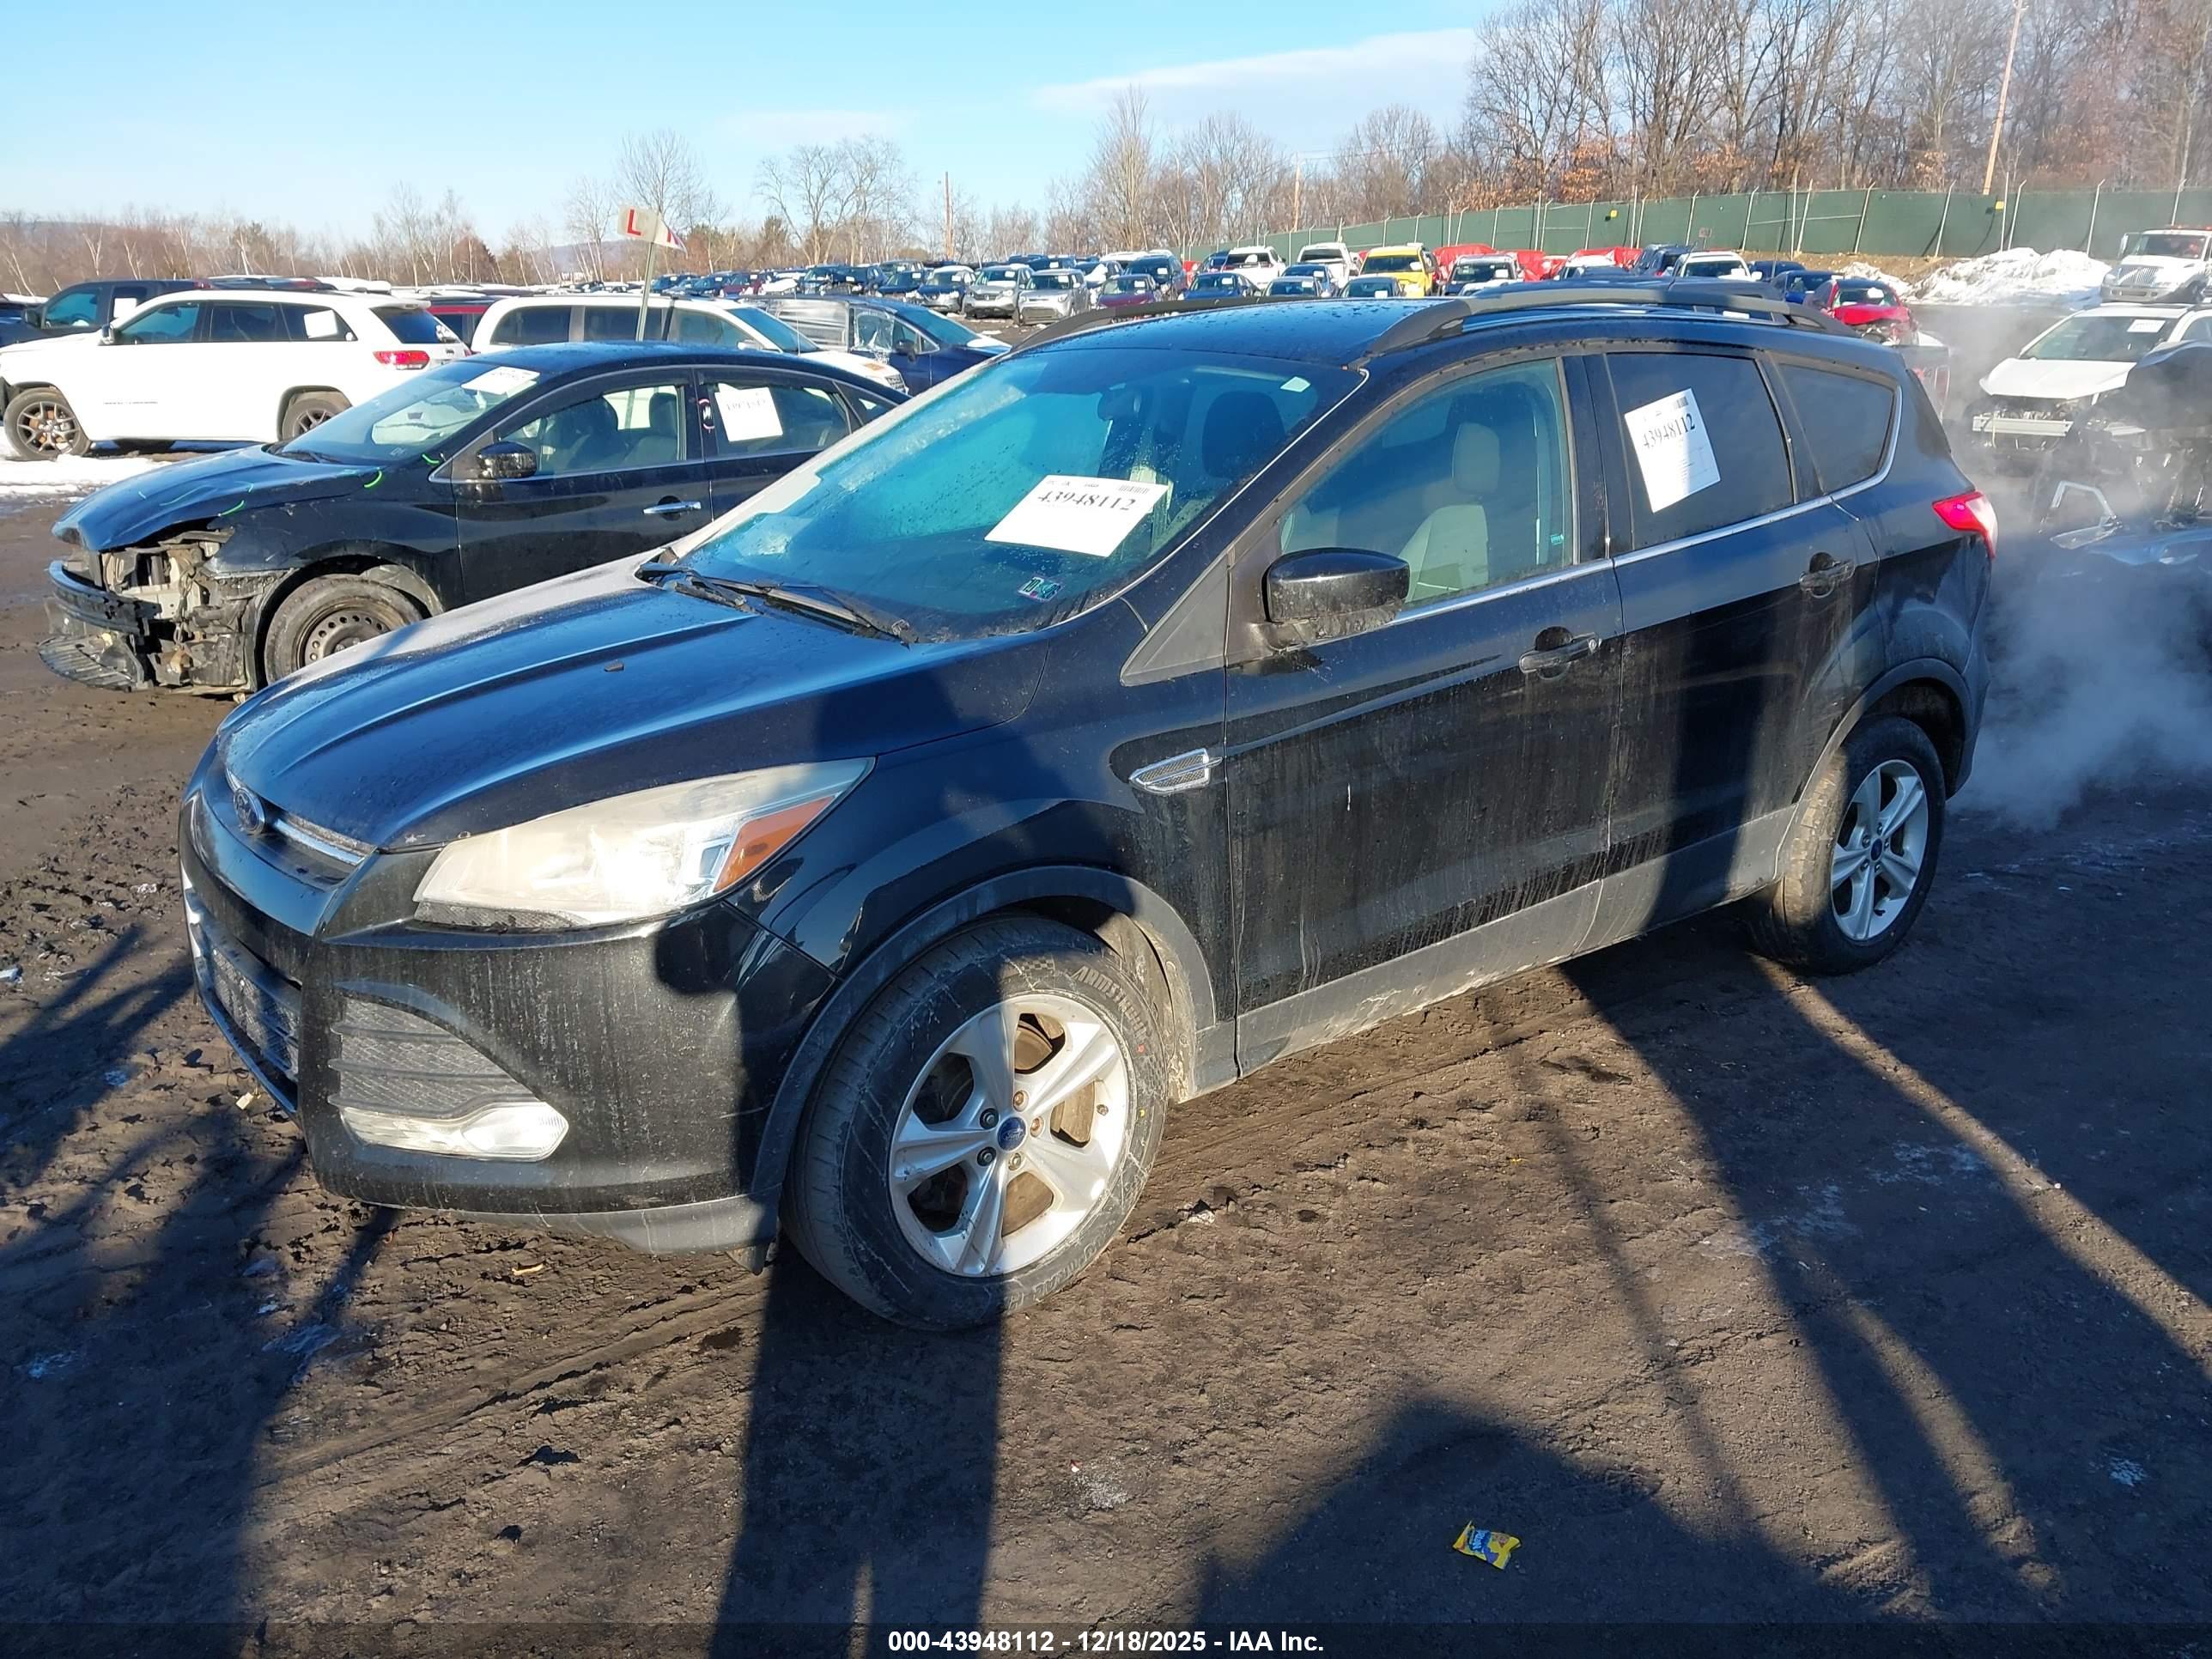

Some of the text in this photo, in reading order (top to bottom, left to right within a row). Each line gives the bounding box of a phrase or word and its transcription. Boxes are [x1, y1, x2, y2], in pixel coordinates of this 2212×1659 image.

[627, 209, 642, 236] L
[1643, 413, 1695, 449] 43948112
[1037, 489, 1136, 511] 43948112
